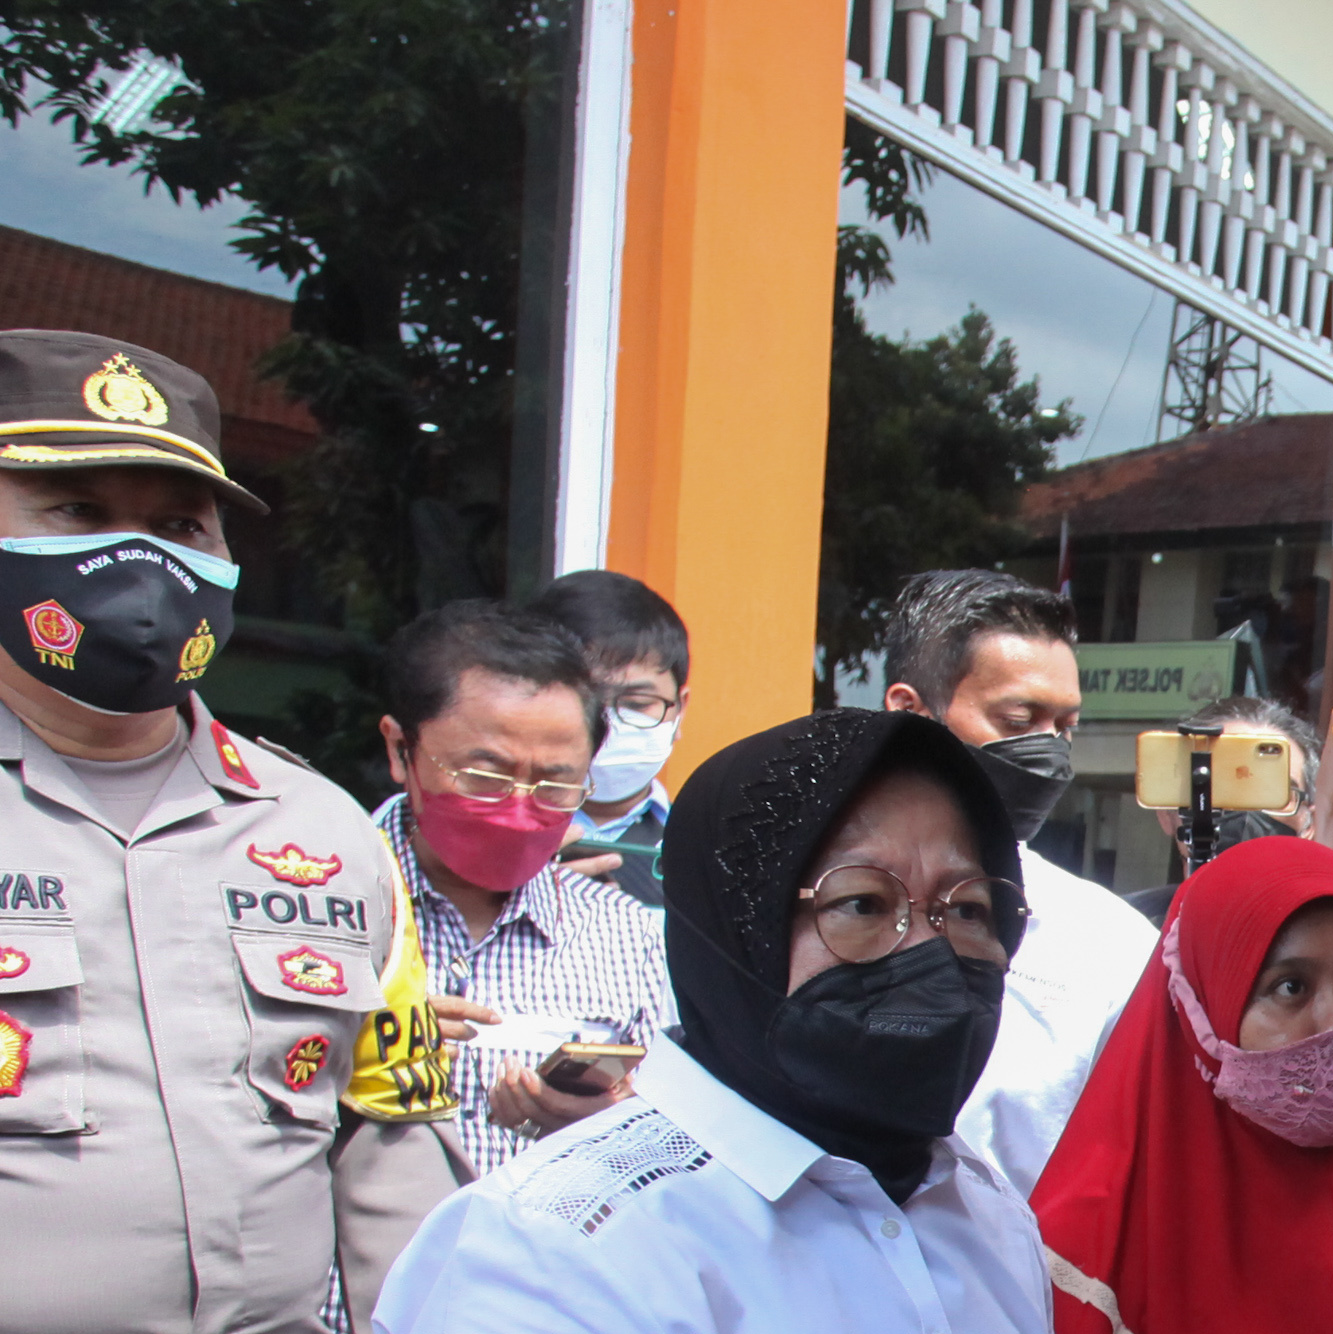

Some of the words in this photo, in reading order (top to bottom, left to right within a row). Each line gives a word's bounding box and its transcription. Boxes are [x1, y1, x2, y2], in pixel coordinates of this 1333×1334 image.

[76, 554, 114, 575] SAYA
[116, 549, 163, 565] SUDAH
[165, 558, 198, 594] VAKSIN
[35, 648, 75, 671] TNI
[226, 887, 368, 932] POLRI
